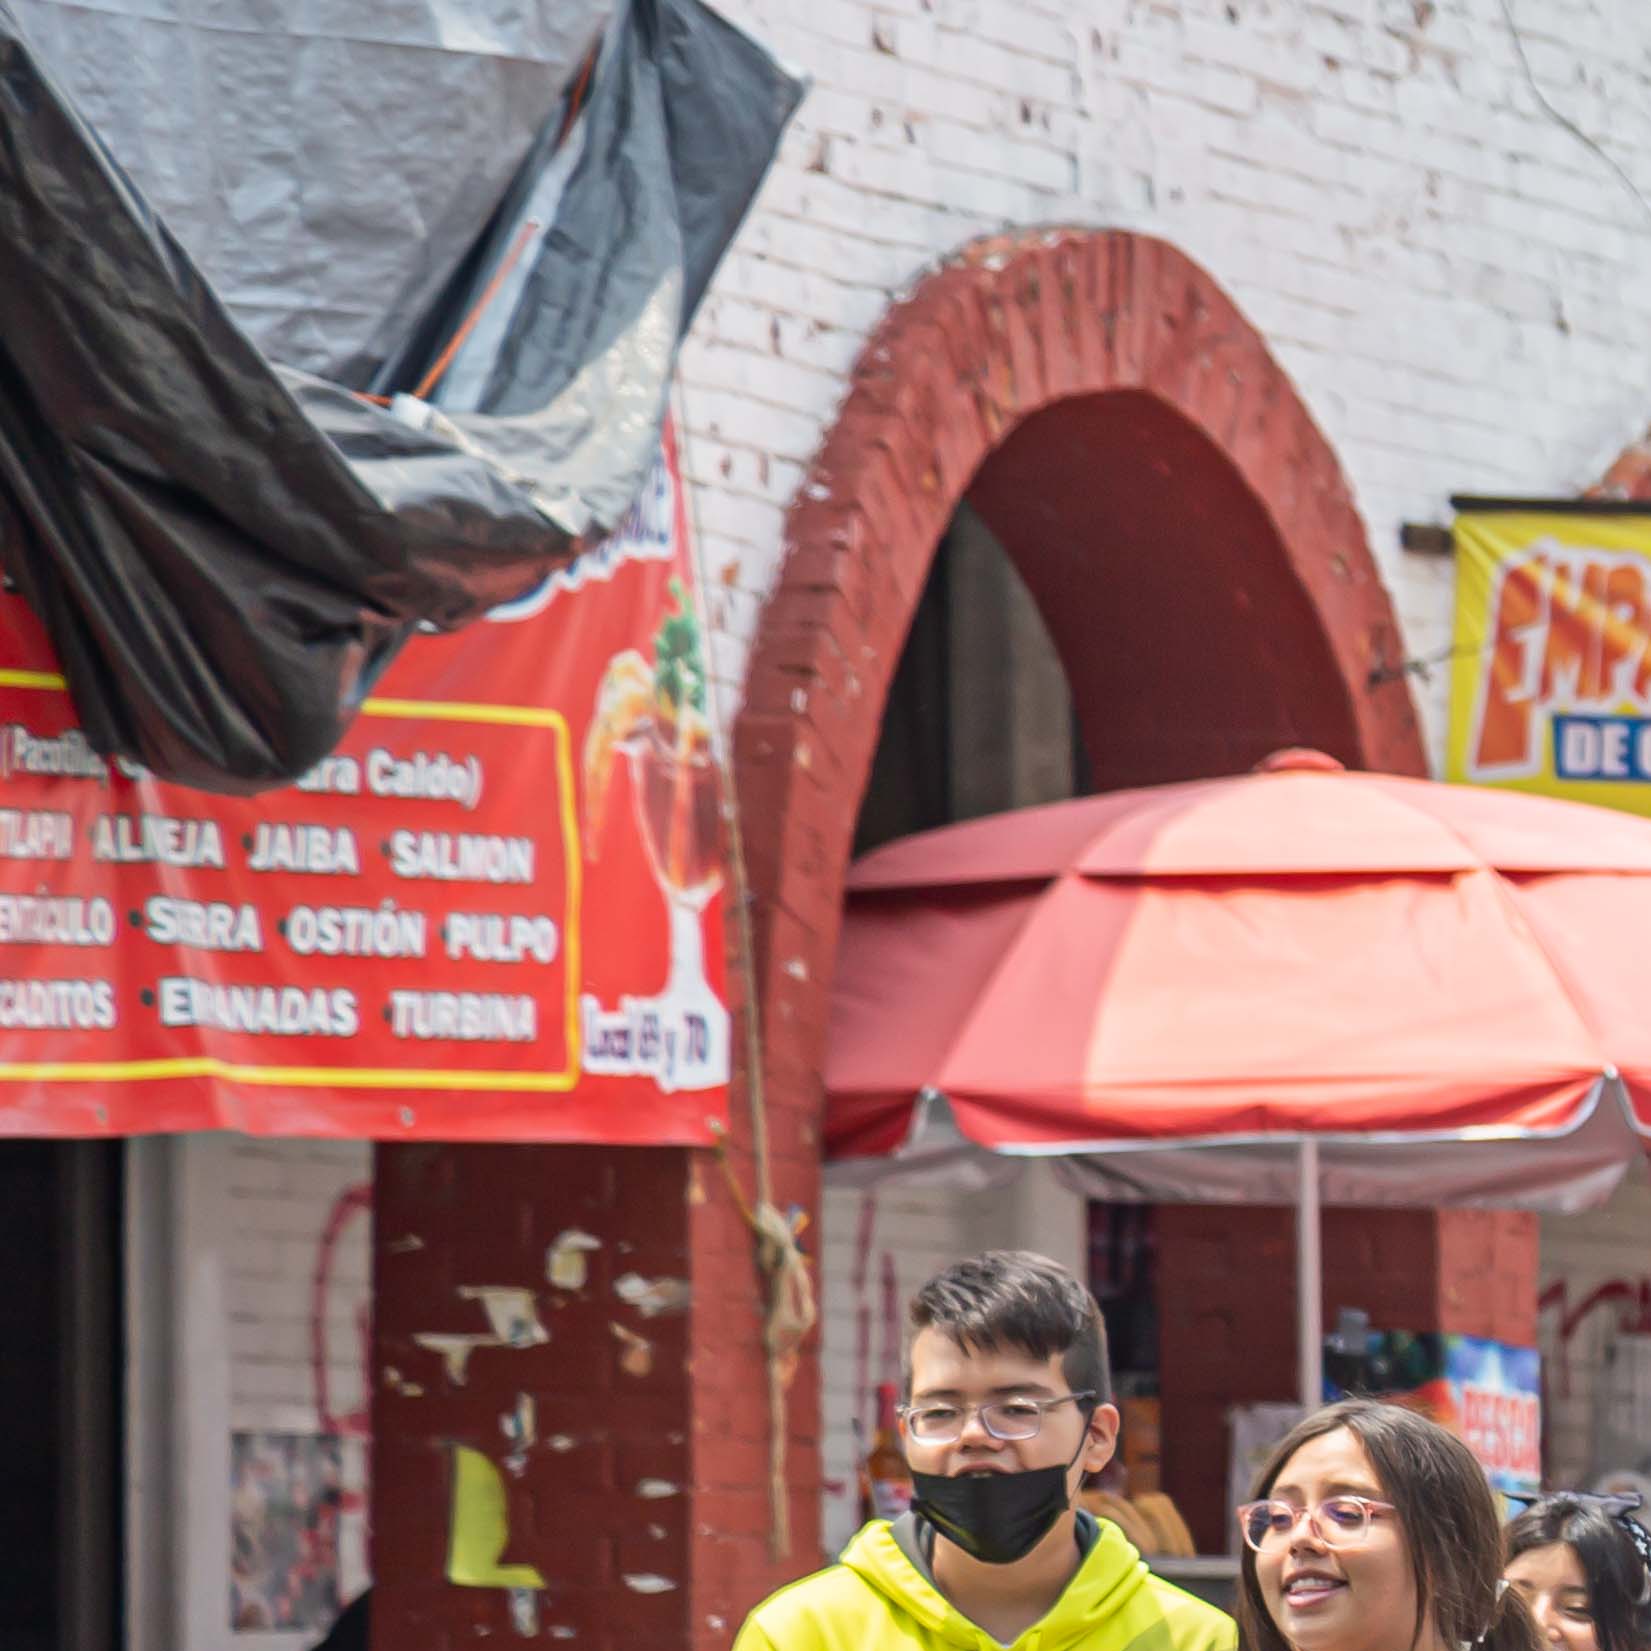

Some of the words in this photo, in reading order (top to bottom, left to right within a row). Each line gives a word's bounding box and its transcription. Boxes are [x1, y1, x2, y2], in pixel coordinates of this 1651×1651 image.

[367, 748, 482, 811] Caldo)
[1563, 721, 1633, 778] DE
[248, 821, 359, 875] JAIBA
[390, 828, 534, 885] SALMON
[287, 896, 427, 958] OSTIÓN
[443, 910, 558, 964] PULPO
